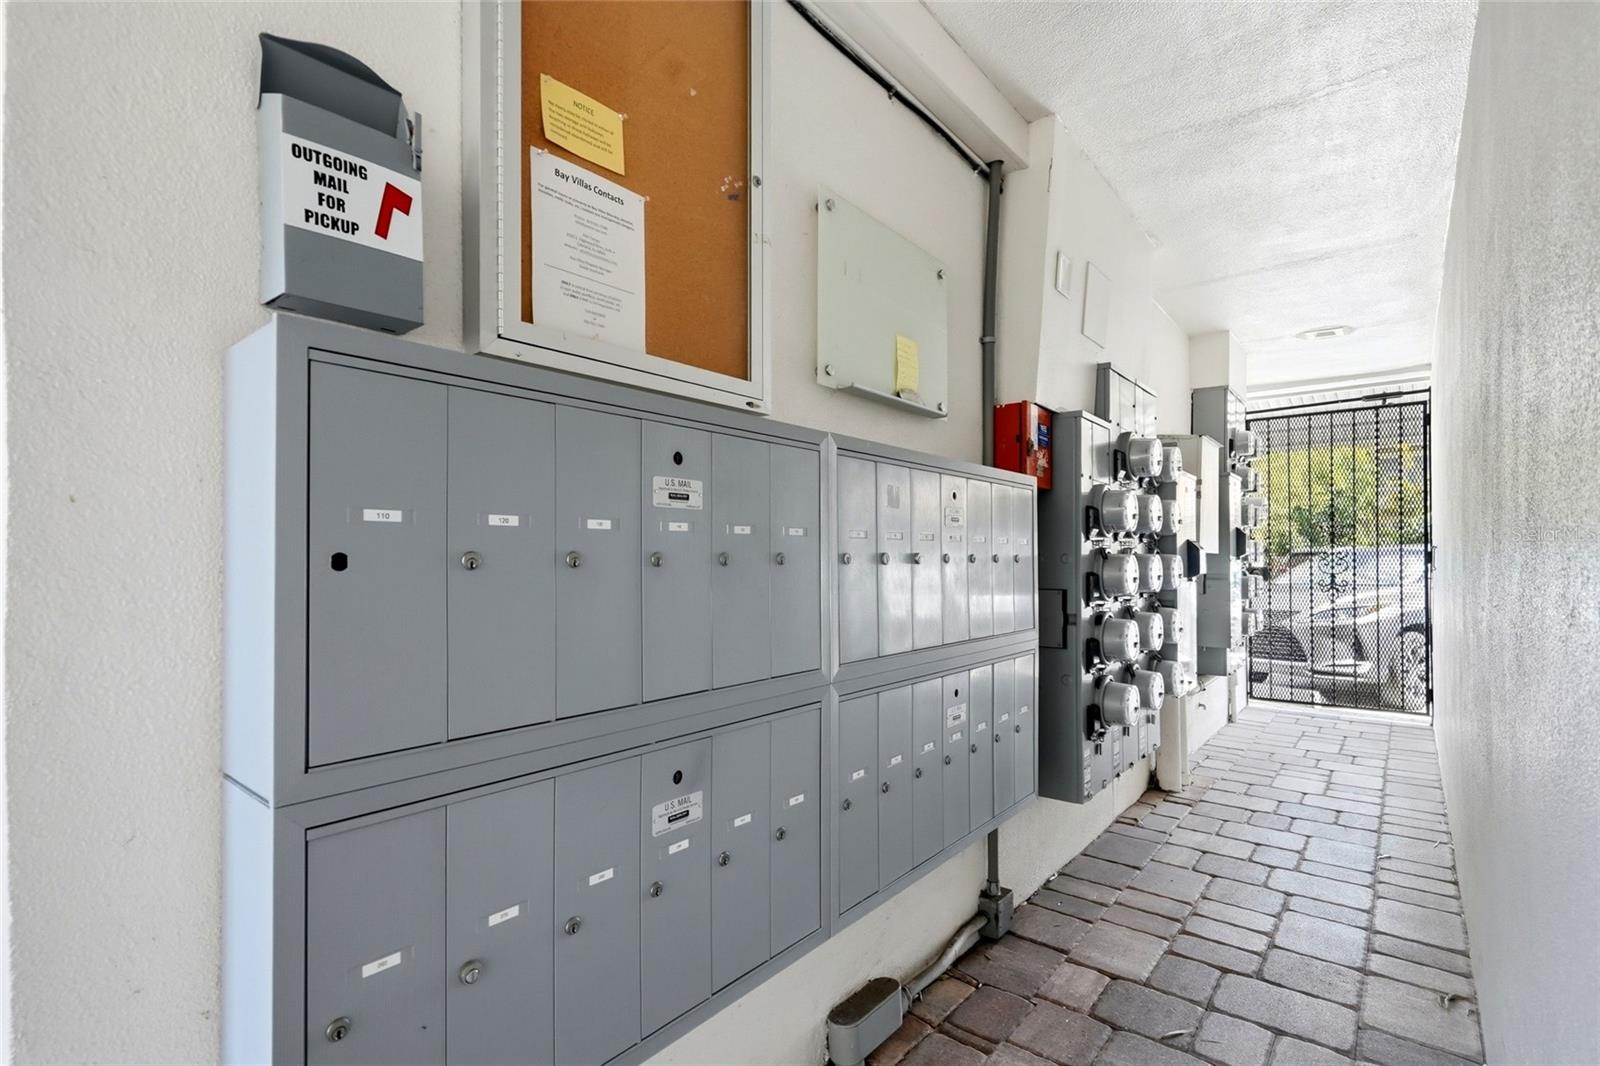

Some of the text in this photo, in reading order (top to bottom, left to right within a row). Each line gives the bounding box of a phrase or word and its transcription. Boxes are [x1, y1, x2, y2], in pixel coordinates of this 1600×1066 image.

[573, 100, 595, 116] NOTICE
[291, 143, 368, 181] OUTGOING
[313, 170, 349, 194] MAIL
[554, 168, 624, 205] Bay Villas Contacts
[317, 192, 346, 213] FOR
[304, 208, 359, 236] PICKUP
[678, 479, 692, 489] MAIL
[376, 512, 390, 520] 110
[678, 796, 692, 806] MAIL
